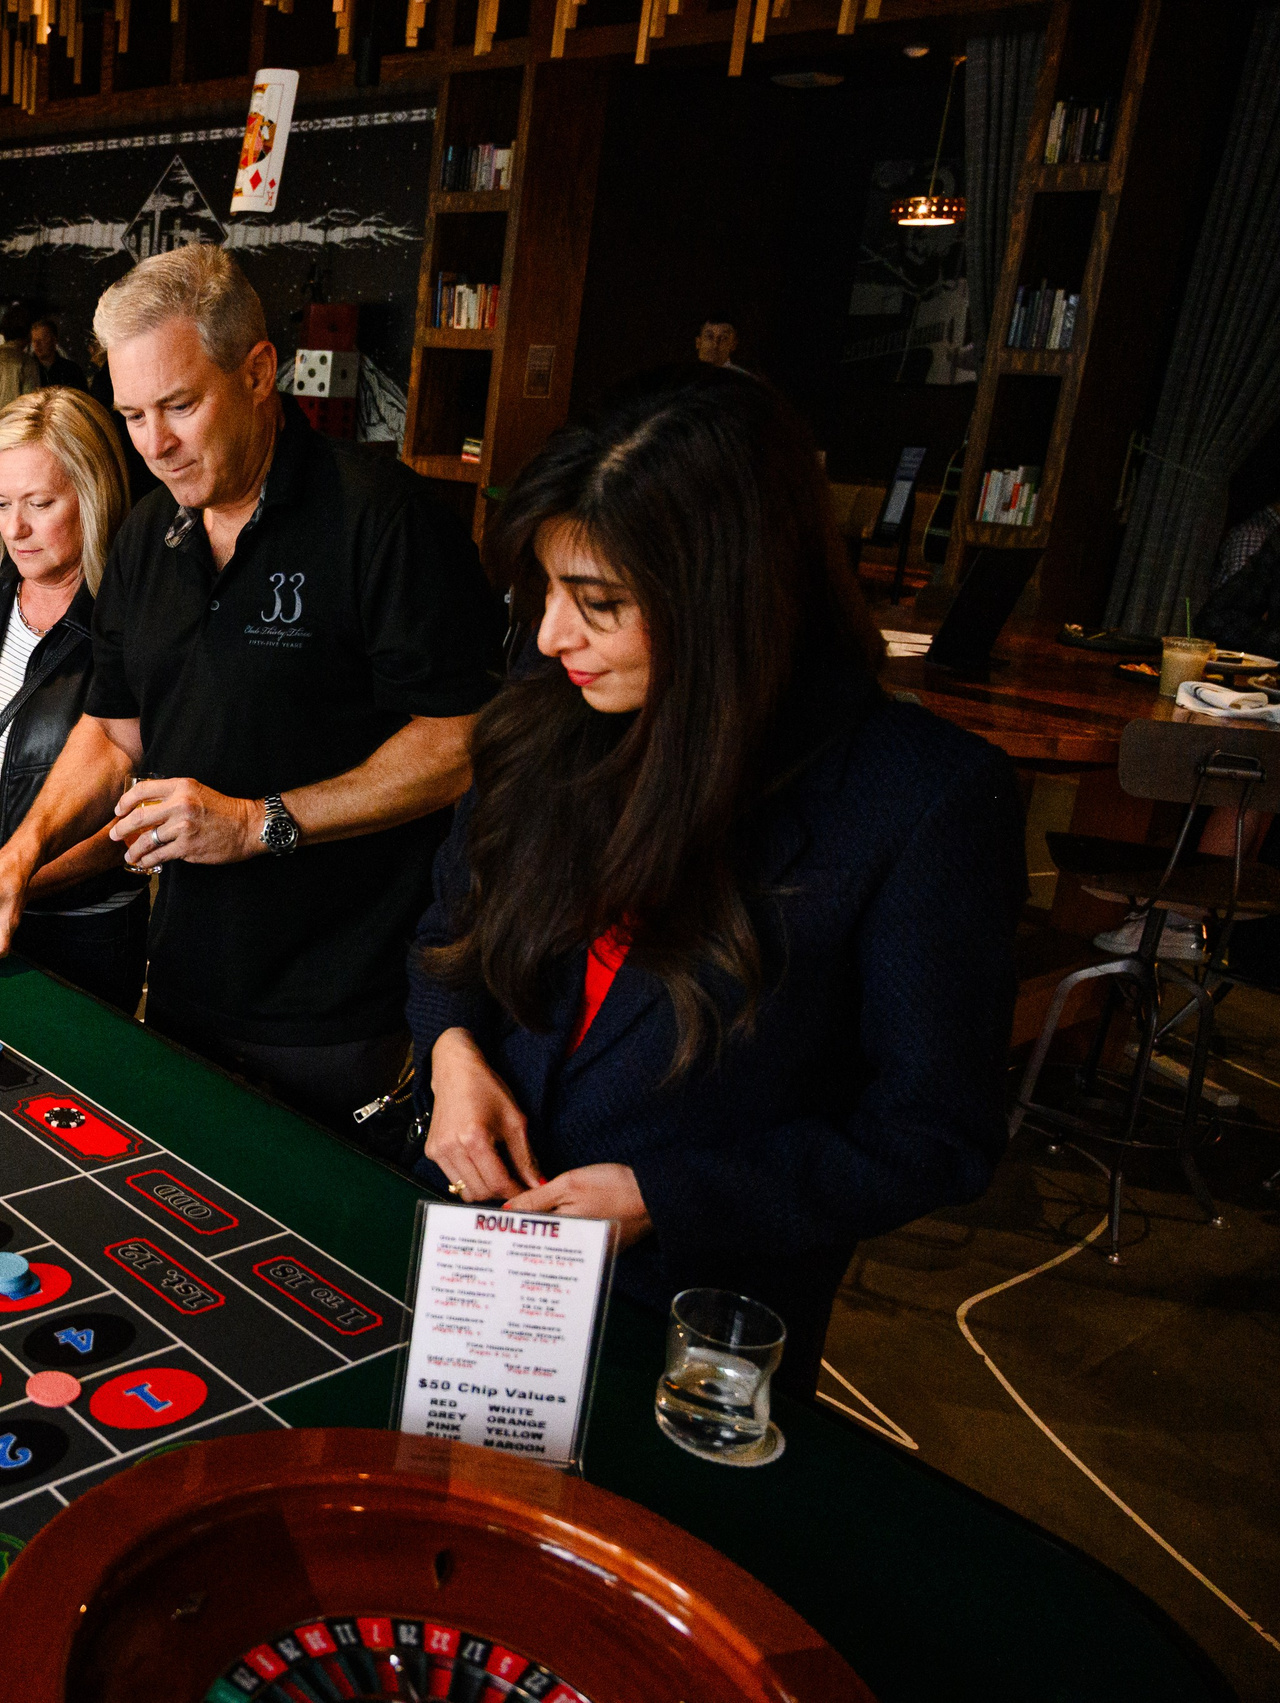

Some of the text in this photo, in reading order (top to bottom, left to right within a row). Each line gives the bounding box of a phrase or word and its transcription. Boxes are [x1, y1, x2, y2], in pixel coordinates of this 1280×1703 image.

[261, 572, 305, 623] 33
[153, 1184, 212, 1219] ODD
[474, 1213, 561, 1238] ROULETTE
[117, 1243, 164, 1270] 12
[269, 1263, 315, 1289] 18
[336, 1307, 368, 1326] 1
[54, 1326, 95, 1354] 4
[123, 1382, 173, 1413] 1
[418, 1377, 567, 1404] $50 Chip Values
[430, 1397, 458, 1408] RED
[488, 1404, 535, 1417] WHITE
[426, 1420, 461, 1432] PINK
[428, 1409, 467, 1421] GREY
[486, 1415, 547, 1429] ORANGE
[485, 1426, 545, 1440] YELLOW
[483, 1438, 546, 1454] MAROON
